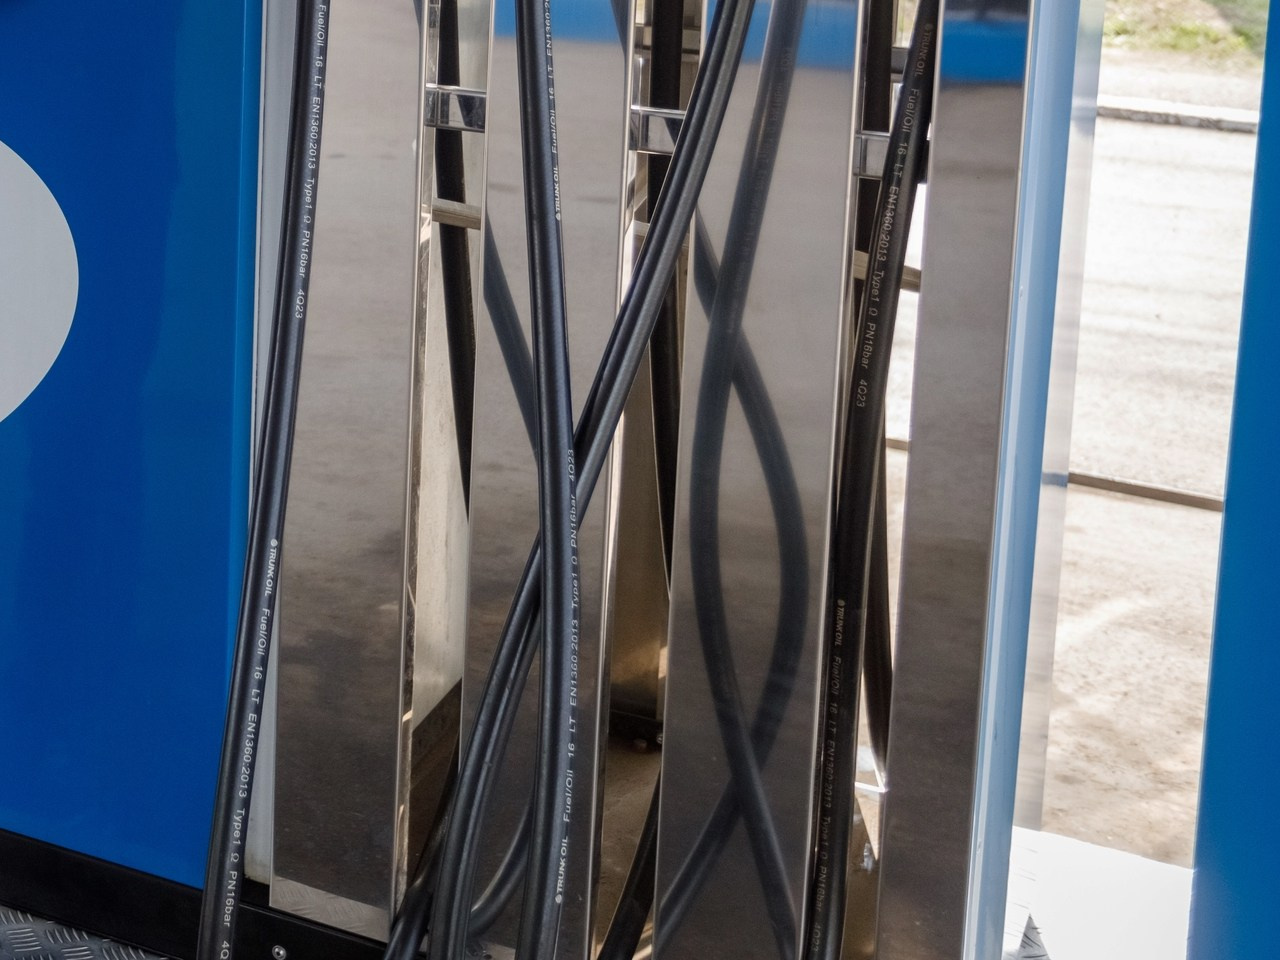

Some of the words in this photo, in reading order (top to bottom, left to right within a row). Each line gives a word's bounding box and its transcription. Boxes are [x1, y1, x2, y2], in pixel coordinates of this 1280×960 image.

[317, 4, 326, 46] Fuel/Oil
[315, 55, 323, 67] 16
[314, 75, 322, 89] LT
[902, 88, 920, 133] Fuel/Oil
[308, 96, 320, 169] EN1360:2013
[897, 142, 908, 155] 16
[893, 163, 903, 177] LT
[304, 177, 315, 209] Type1
[299, 230, 311, 278] PN16bar
[295, 288, 305, 319] 4Q23
[871, 269, 885, 303] Type1
[861, 323, 876, 370] PN16bar
[571, 572, 579, 609] Type1
[257, 608, 270, 656] Fuel/Oil
[254, 666, 263, 679] 16
[570, 619, 579, 707] EN1360:2013
[251, 688, 260, 704] LT
[569, 716, 577, 732] LT
[238, 713, 257, 797] EN1360:2013
[568, 743, 575, 758] 16
[563, 770, 573, 822] Fuel/Oil
[233, 808, 245, 844] Type1
[224, 870, 238, 927] PN16bar
